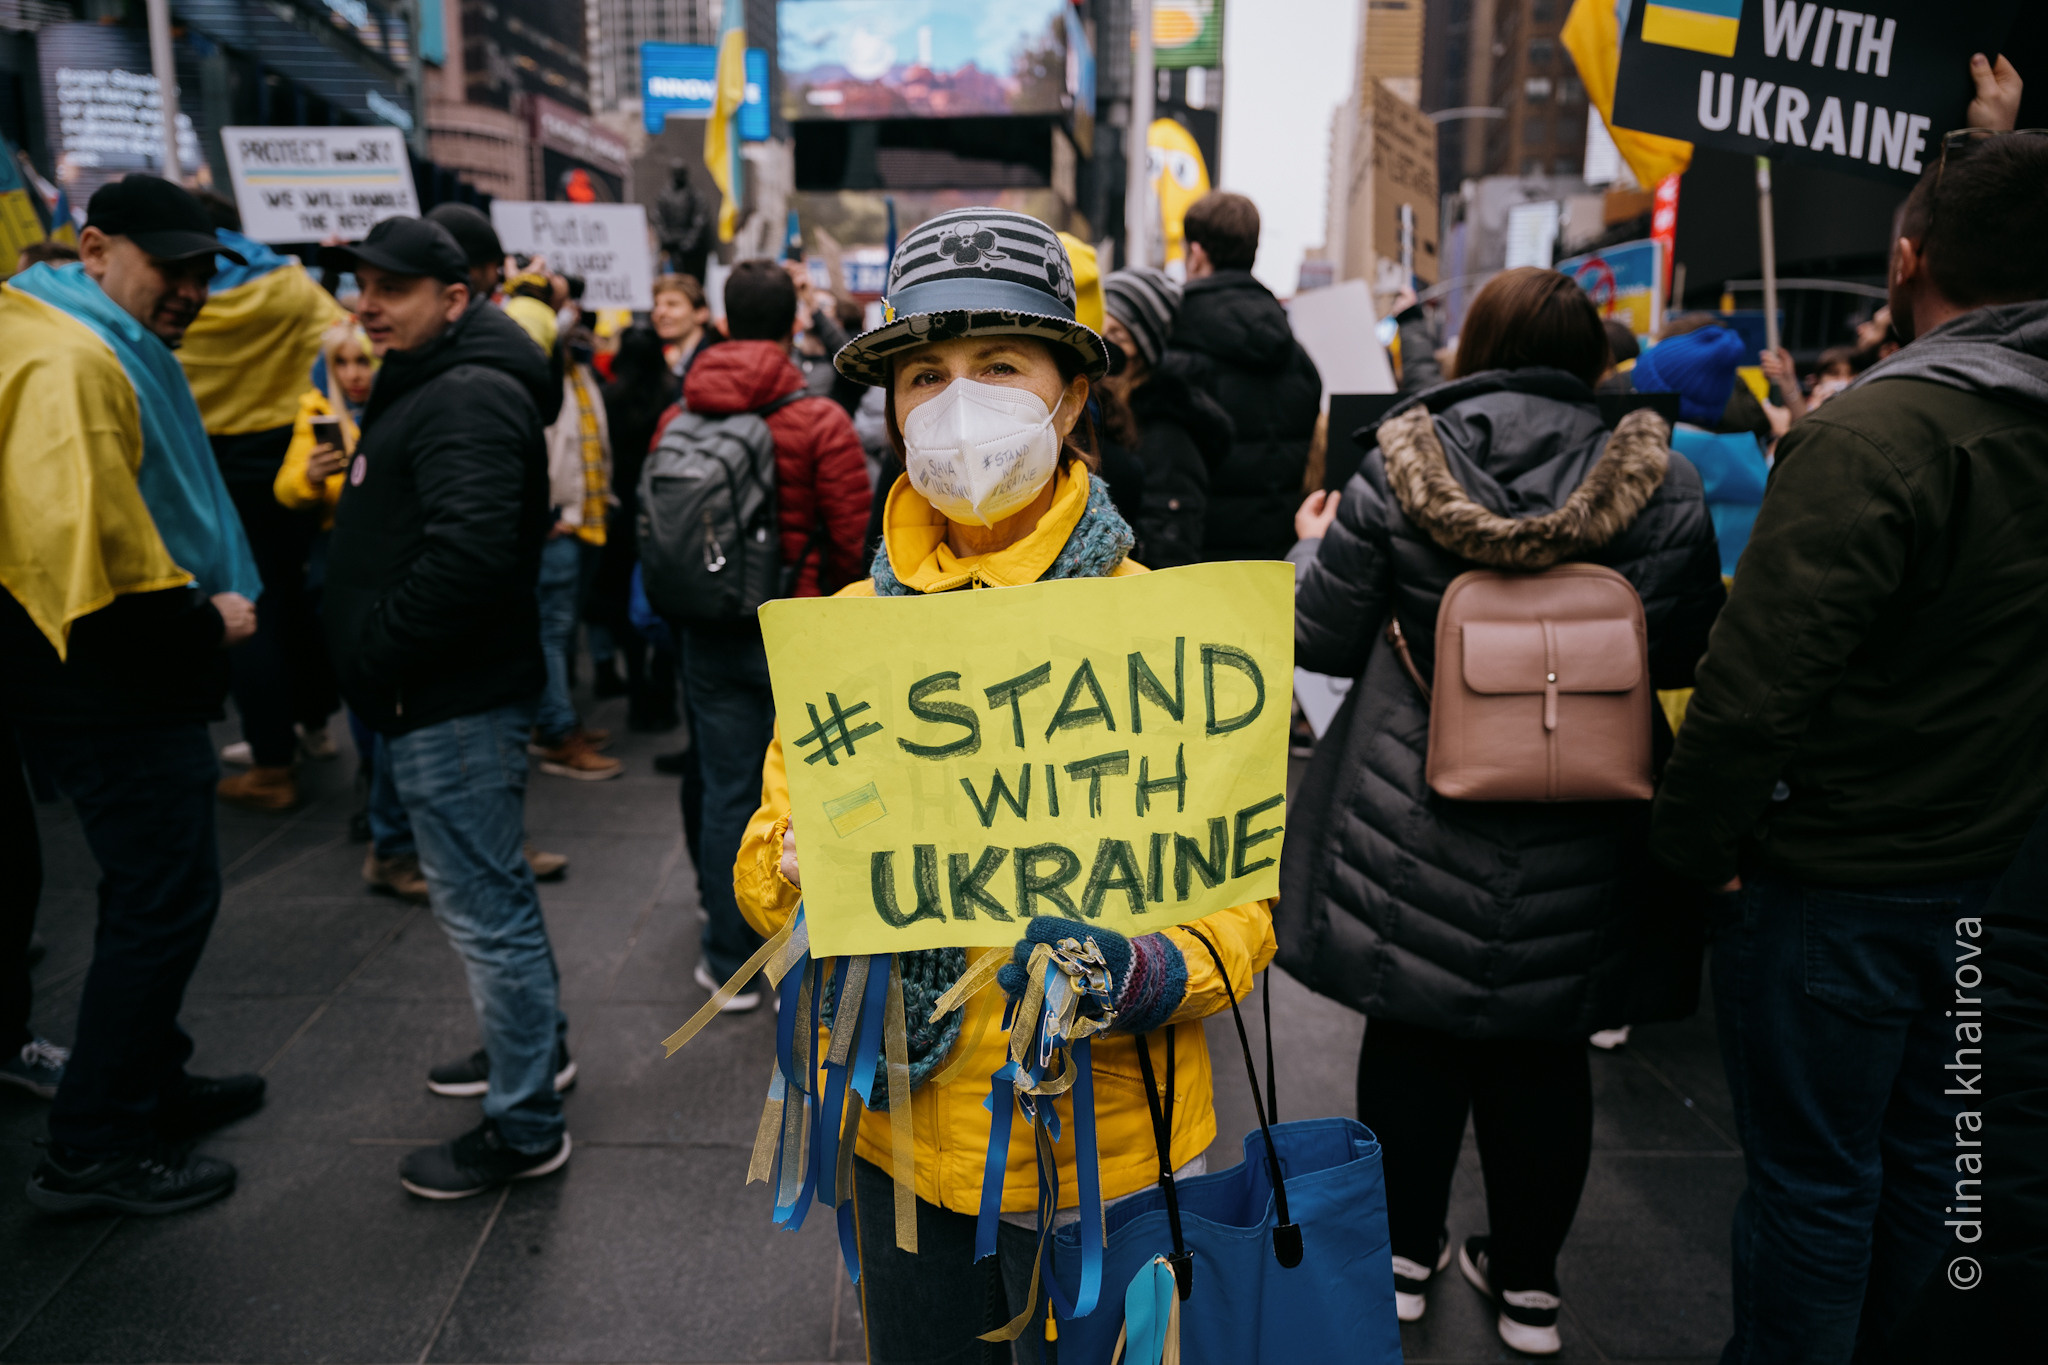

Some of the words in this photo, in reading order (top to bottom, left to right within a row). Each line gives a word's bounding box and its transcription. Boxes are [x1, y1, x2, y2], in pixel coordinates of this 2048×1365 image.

[1763, 0, 1897, 77] WITH
[1698, 70, 1931, 175] UKRAINE
[532, 206, 610, 247] Putin
[1002, 458, 1025, 480] WITH
[793, 636, 1266, 763] #STAND
[959, 742, 1188, 829] WITH
[870, 793, 1287, 929] UKRAINE
